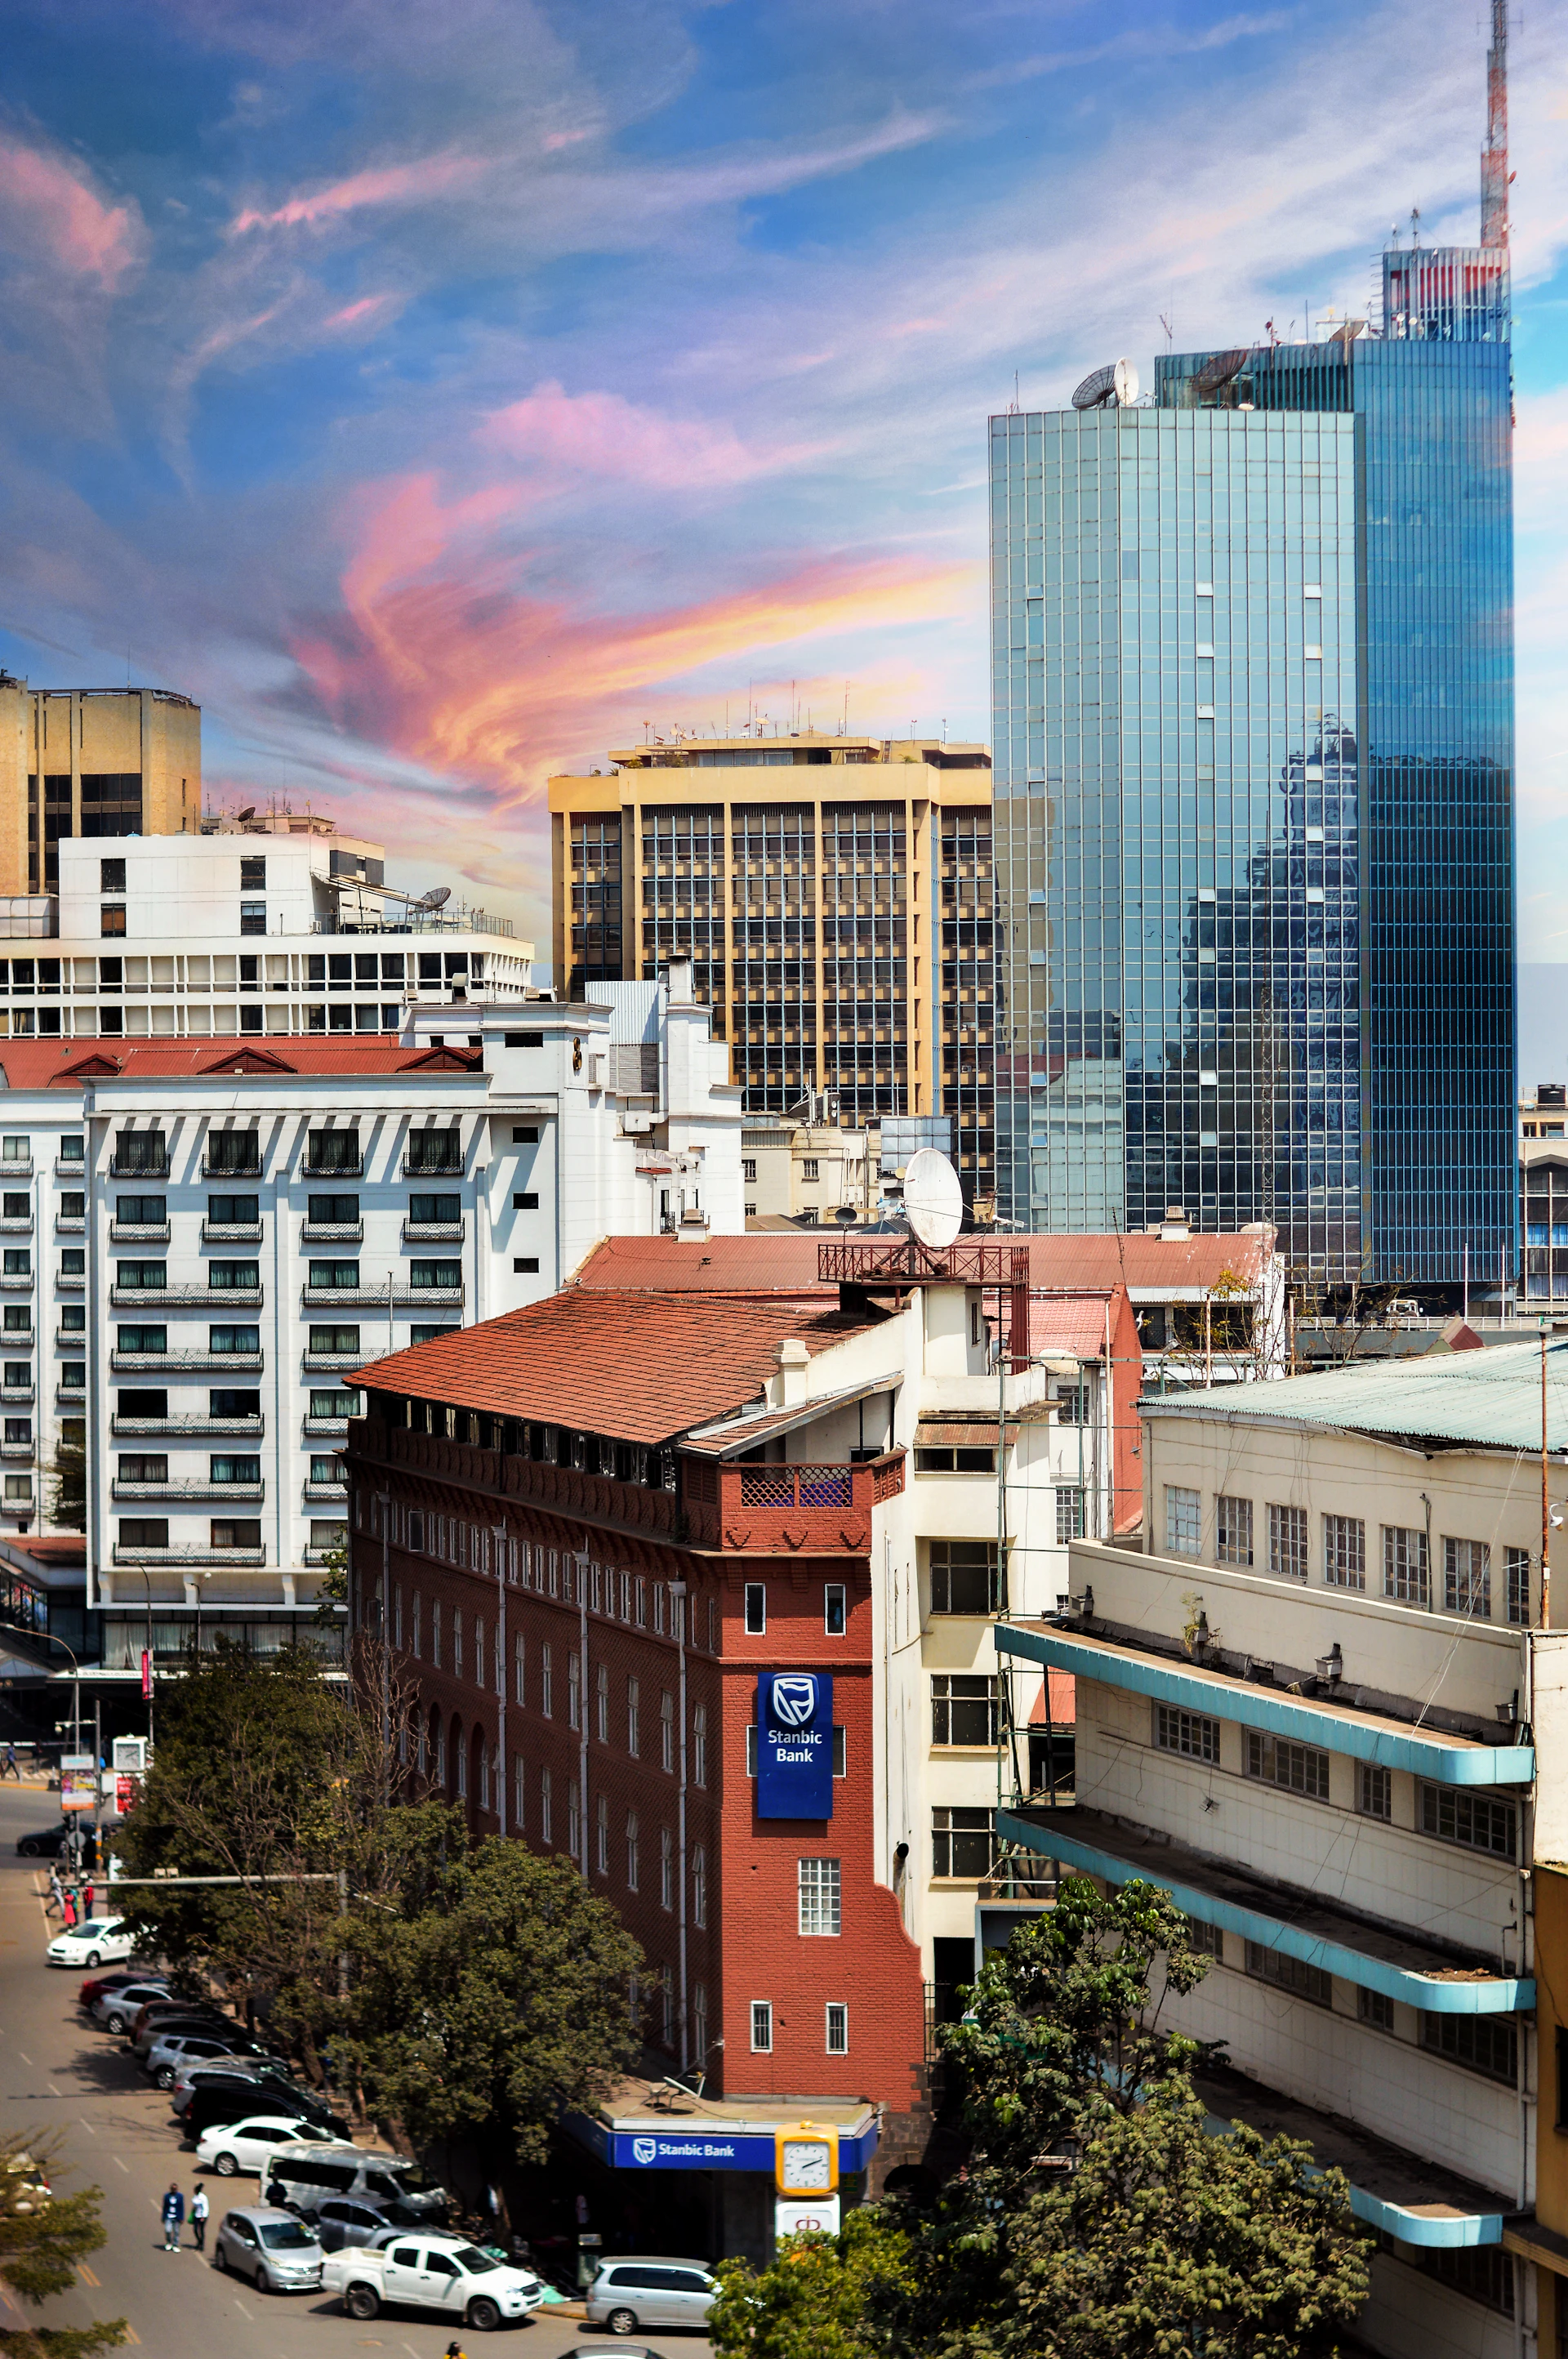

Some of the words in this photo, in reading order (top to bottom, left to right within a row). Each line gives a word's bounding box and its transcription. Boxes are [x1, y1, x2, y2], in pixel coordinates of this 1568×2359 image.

[768, 1729, 822, 1744] Stanbic
[777, 1748, 813, 1762] Bank
[658, 2143, 702, 2156] Stanbic
[704, 2144, 735, 2156] Bank
